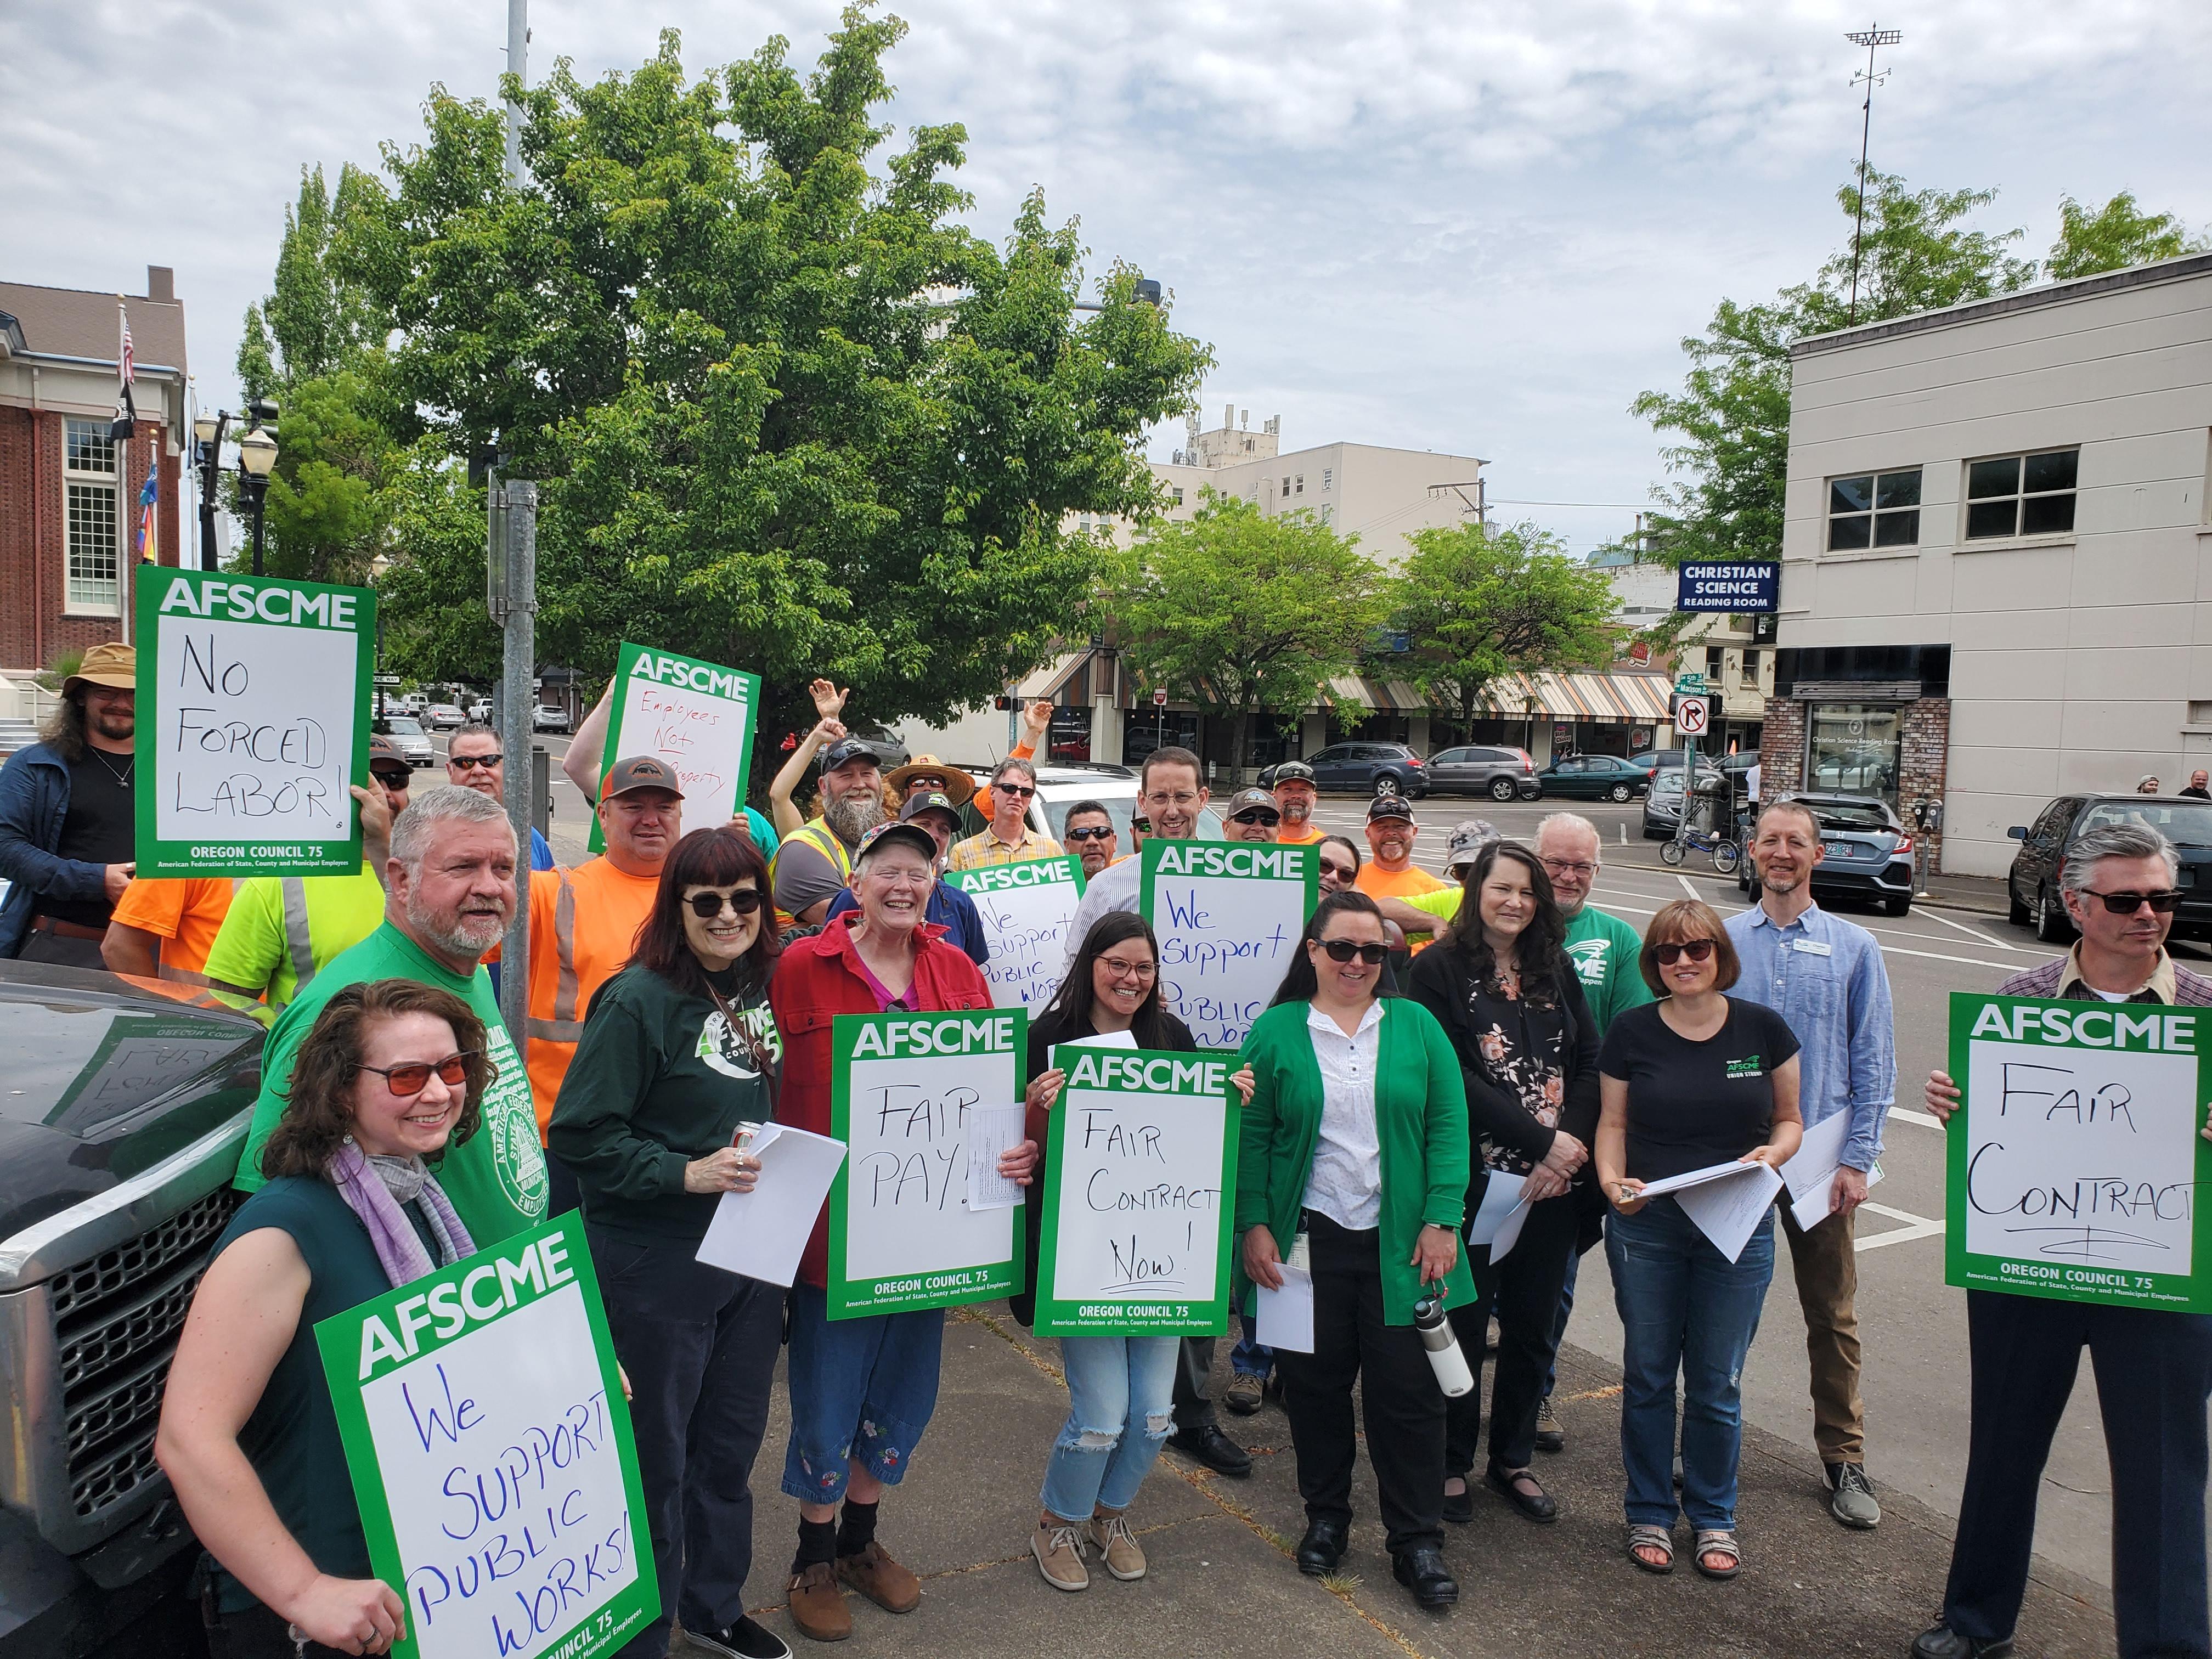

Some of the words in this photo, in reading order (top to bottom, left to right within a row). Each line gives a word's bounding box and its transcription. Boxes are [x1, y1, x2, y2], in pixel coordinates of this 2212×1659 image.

[1685, 567, 1771, 579] CHRISTIAN
[1695, 582, 1758, 594] SCIENCE
[159, 578, 357, 629] AFSCME
[1684, 598, 1731, 606] READING
[630, 653, 749, 702] AFSCME
[1680, 684, 1701, 693] Madison
[641, 691, 720, 725] Employees
[178, 708, 326, 769] FORCED
[654, 726, 694, 748] Not
[177, 765, 342, 829] LABOR!
[191, 847, 245, 858] OREGON
[250, 847, 304, 857] COUNCIL
[308, 846, 323, 857] 75
[1156, 845, 1304, 878] AFSCME
[961, 860, 1073, 893] AFSCME
[1166, 889, 1216, 929] We
[1161, 923, 1288, 975] Support
[1021, 978, 1059, 1002] WOR
[851, 1018, 1013, 1057] AFSCME
[1187, 1023, 1252, 1046] WOR
[1970, 1003, 2196, 1051] AFSCME
[1069, 1054, 1226, 1094] AFSCME
[866, 1085, 979, 1142] FAIR
[2000, 1063, 2136, 1133] FAIR
[1079, 1109, 1165, 1164] FAIR
[1088, 1169, 1223, 1211] CONTRACT
[1967, 1142, 2212, 1221] CONTRACT
[874, 1279, 921, 1295] OREGON
[926, 1273, 972, 1289] COUNCIL
[976, 1270, 988, 1282] 75
[962, 1285, 985, 1293] Municipal
[987, 1281, 1011, 1289] Employees
[1966, 1272, 1998, 1281] American
[2000, 1276, 2037, 1286] Federation
[2049, 1282, 2069, 1290] State,
[2071, 1284, 2096, 1294] County
[2114, 1289, 2148, 1298] Municipal
[2151, 1292, 2190, 1302] Employees
[2001, 1263, 2059, 1280] OREGON
[2066, 1269, 2129, 1287] COUNCIL
[2135, 1277, 2153, 1289] 75
[359, 1230, 574, 1381] AFSCME
[1079, 1306, 1122, 1317] OREGON
[1127, 1306, 1172, 1317] COUNCIL
[1176, 1306, 1188, 1317] 75
[403, 1364, 486, 1452] We
[442, 1390, 605, 1540] SUPPORT
[405, 1489, 588, 1626] PUBLIC
[492, 1510, 628, 1658] WORKS!
[583, 1631, 612, 1659] Municipal
[613, 1608, 642, 1635] Employees
[596, 1609, 612, 1633] 75
